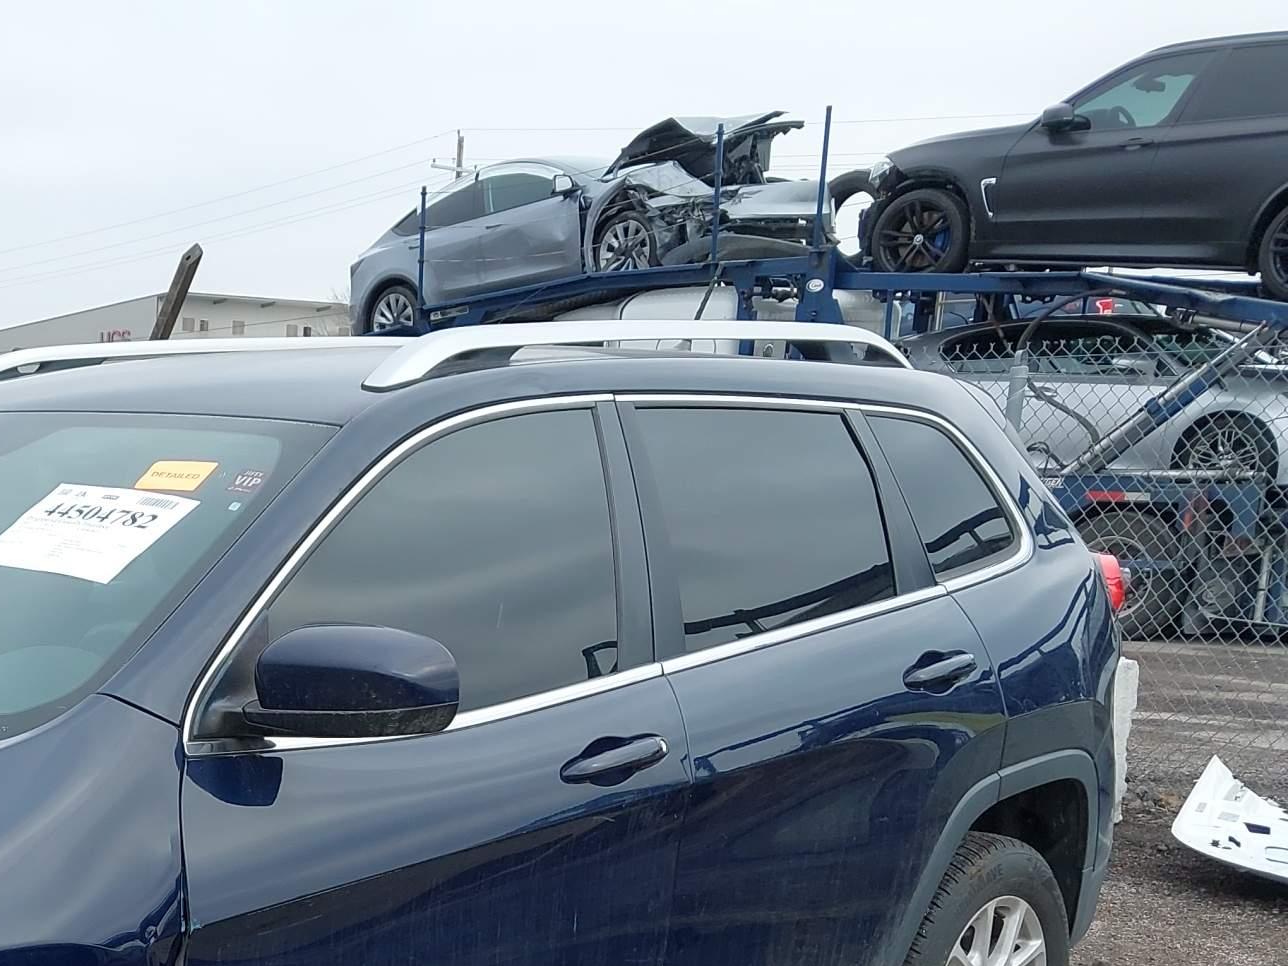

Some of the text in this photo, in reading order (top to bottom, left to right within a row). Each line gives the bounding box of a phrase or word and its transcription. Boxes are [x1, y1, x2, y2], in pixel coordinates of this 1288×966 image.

[150, 471, 201, 480] DETAILED
[233, 475, 263, 487] VIP
[44, 502, 159, 529] 44504782
